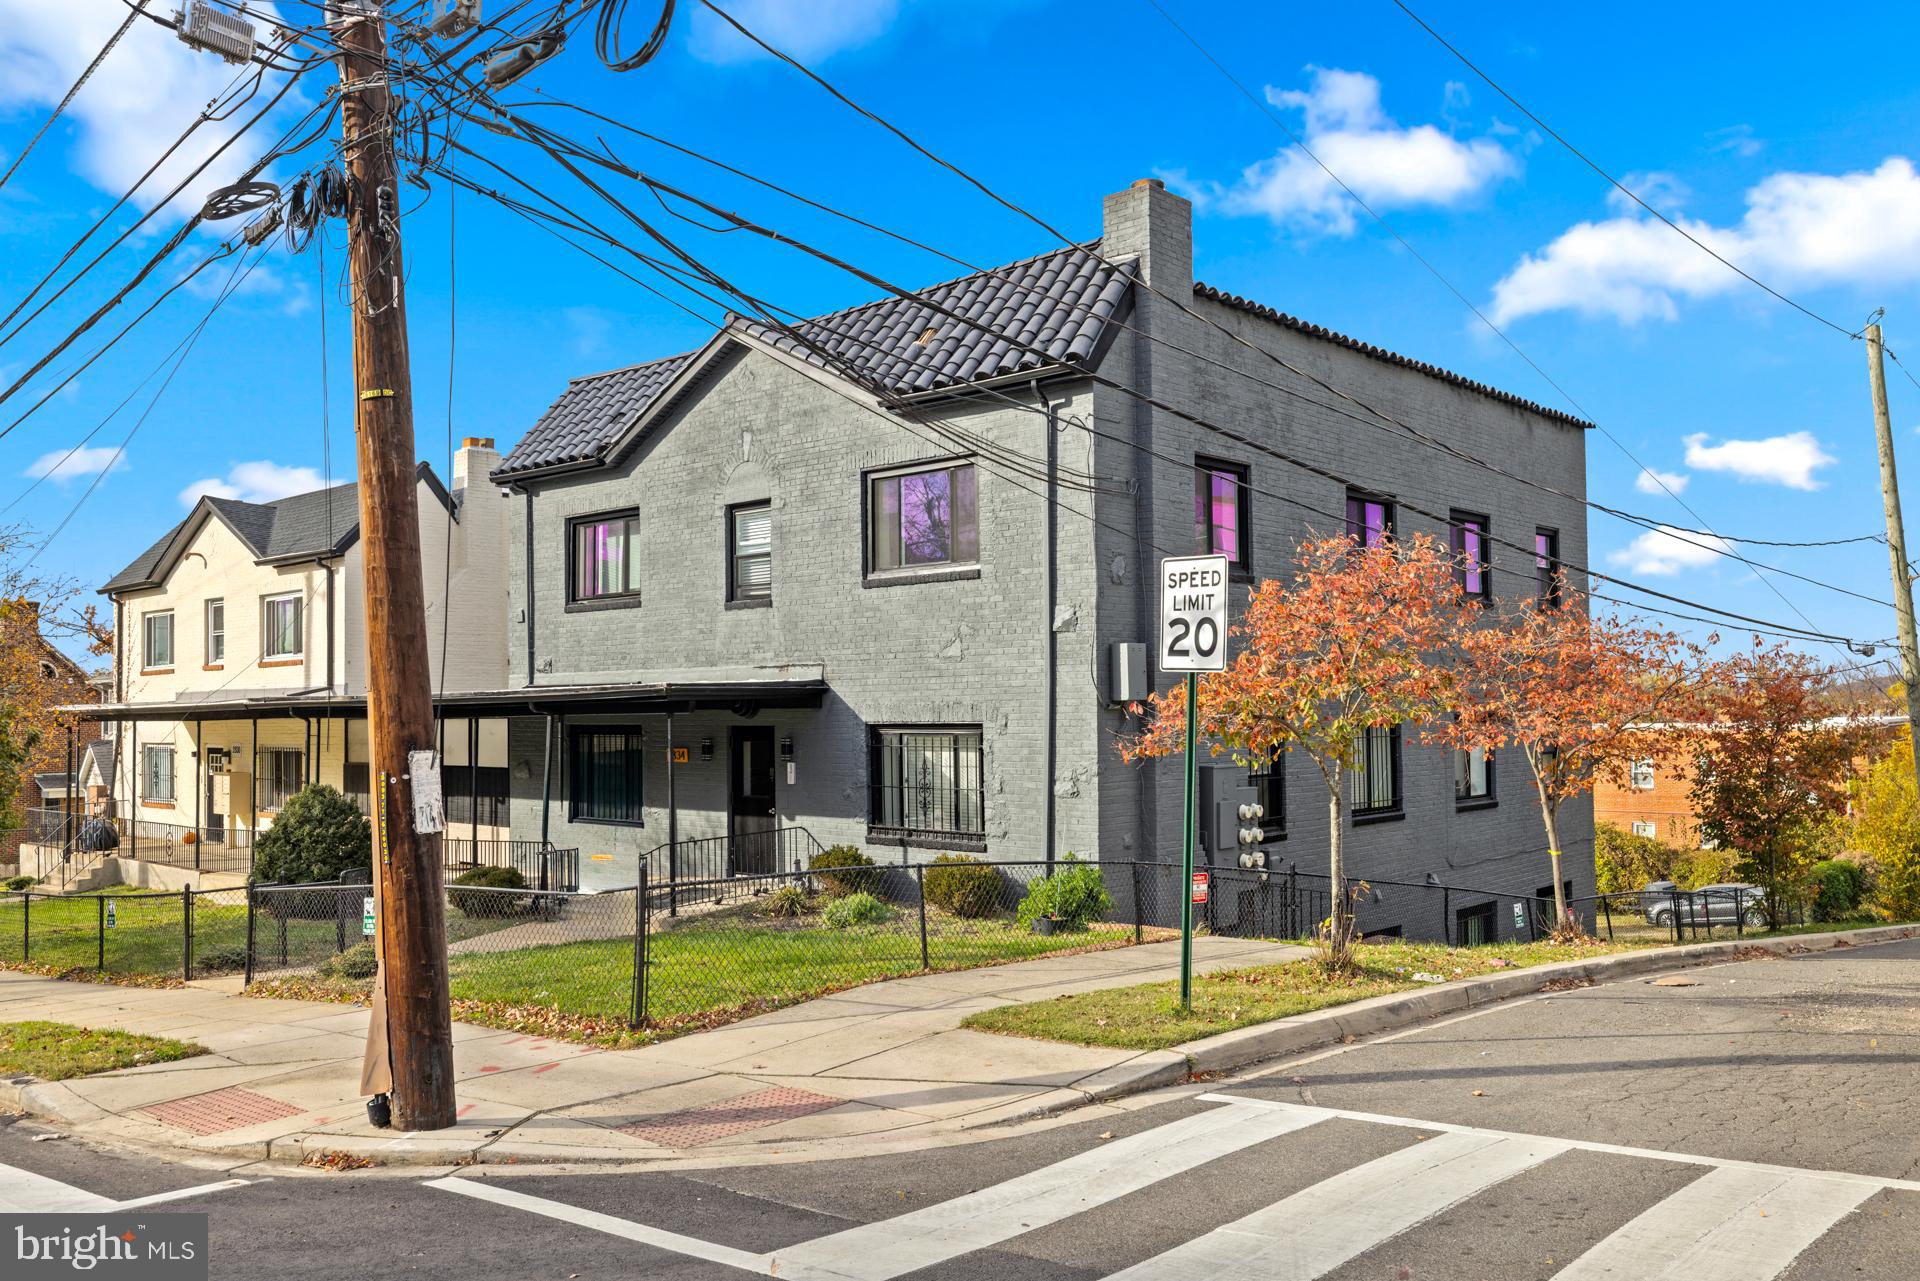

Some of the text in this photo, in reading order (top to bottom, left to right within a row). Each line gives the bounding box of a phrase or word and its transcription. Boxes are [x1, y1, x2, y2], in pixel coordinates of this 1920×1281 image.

[1168, 570, 1221, 589] SPEED
[1173, 594, 1215, 611] LIMIT
[1167, 616, 1218, 657] 20
